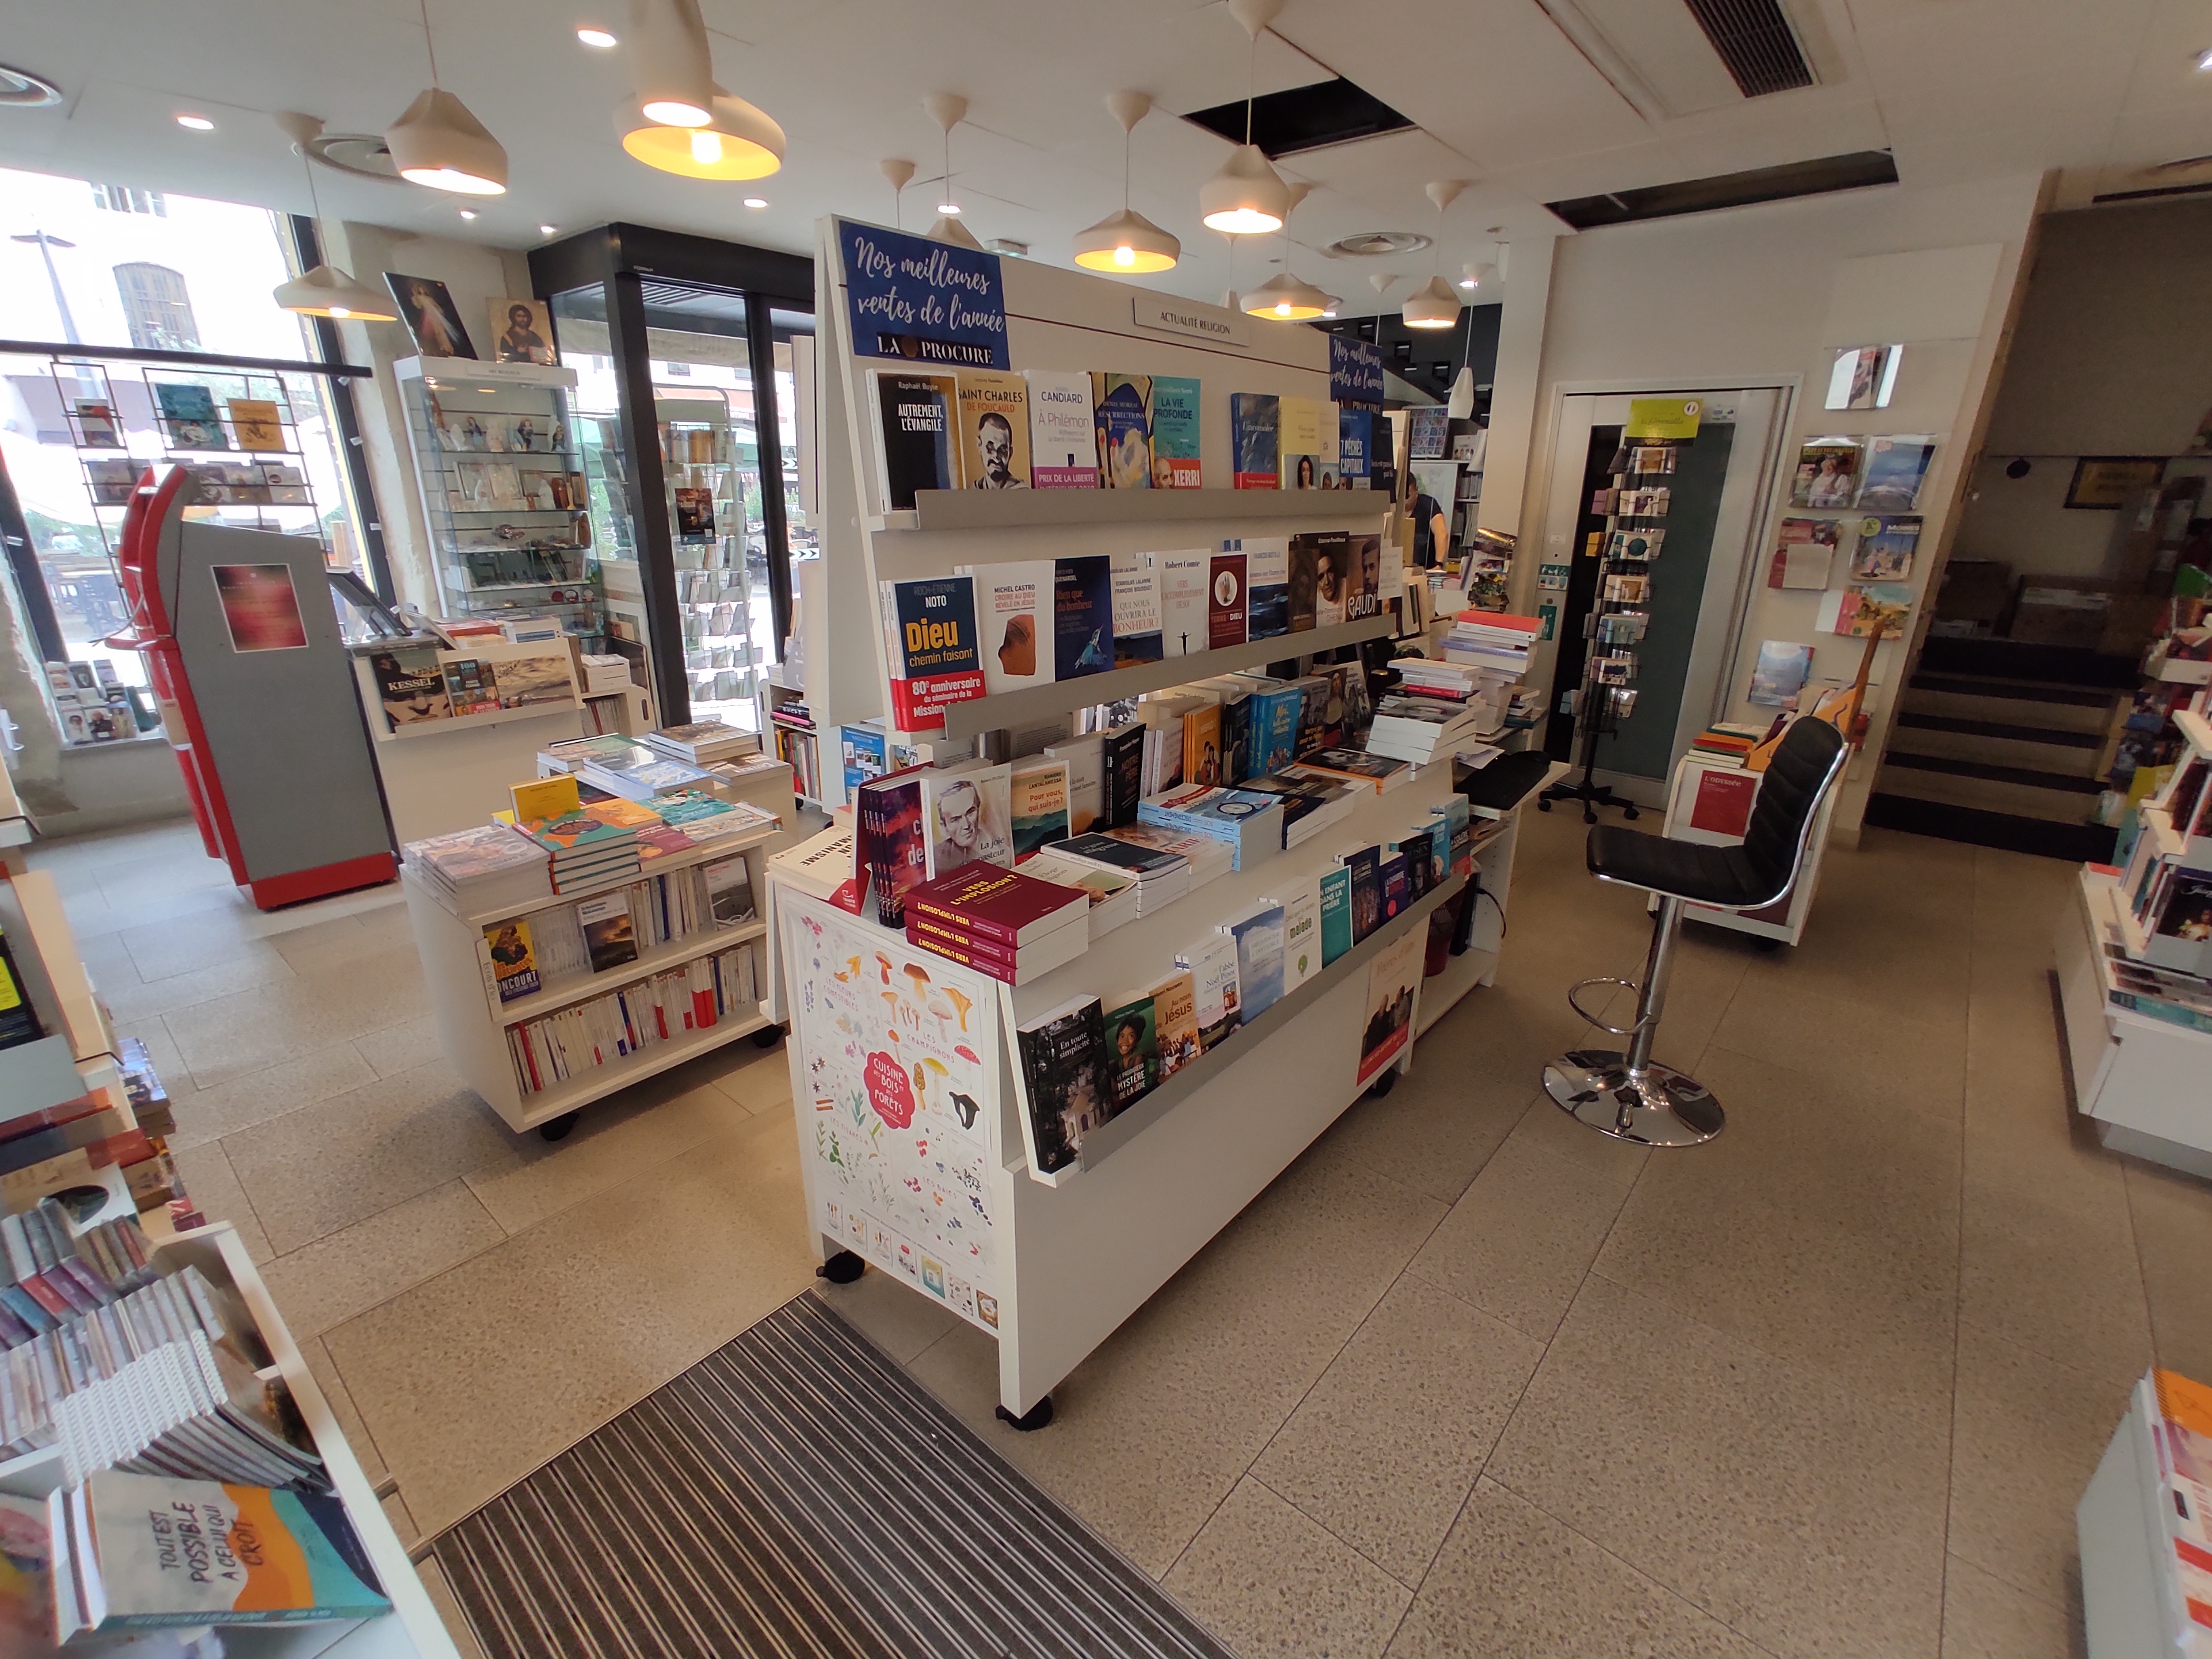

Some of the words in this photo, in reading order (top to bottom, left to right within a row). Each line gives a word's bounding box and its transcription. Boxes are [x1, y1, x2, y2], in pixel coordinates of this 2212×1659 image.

[855, 237, 895, 278] Nos
[901, 249, 990, 295] meilleures
[858, 286, 916, 324] ventes
[920, 295, 945, 325] de
[949, 293, 1004, 333] l'année
[1160, 312, 1197, 329] ACTUALITÉ
[1200, 319, 1231, 335] RELIGION
[877, 336, 900, 354] LA
[922, 341, 993, 365] PROCURE
[1334, 339, 1349, 361] Nos
[898, 382, 921, 391] Raphaël
[958, 388, 982, 401] SAINT
[985, 390, 1023, 403] CHARLES
[1041, 391, 1083, 404] CANDIARD
[1161, 397, 1171, 407] LA
[1172, 398, 1184, 408] VIE
[898, 403, 943, 419] AUTREMENT,
[967, 402, 977, 411] DE
[978, 403, 1015, 413] FOUCAULD
[1098, 411, 1145, 419] RÉSURRECTIONS
[1153, 408, 1193, 419] PROFONDE
[901, 416, 943, 432] L'ÉVANGILE
[1048, 412, 1089, 428] Philémon
[1039, 474, 1052, 482] PRIX
[1054, 474, 1063, 483] DE
[1063, 474, 1072, 483] LA
[1074, 473, 1094, 482] LIBERTÉ
[1173, 469, 1200, 487] XERRI
[1165, 560, 1183, 569] Robert
[994, 586, 1013, 594] MICHEL
[1015, 584, 1035, 592] CASTRO
[994, 593, 1012, 602] CROIRE
[1023, 591, 1035, 599] DIEU
[1056, 590, 1071, 600] Rien
[1071, 591, 1084, 601] que
[925, 595, 947, 609] NOTO
[1120, 601, 1131, 611] QUI
[1132, 599, 1150, 609] NOUS
[1114, 610, 1147, 621] OUVRIRA
[1148, 608, 1155, 617] LE
[1230, 611, 1242, 620] DIEU
[1113, 618, 1154, 634] BONHEUR
[906, 618, 959, 653] Dieu
[909, 650, 941, 668] chemin
[943, 648, 973, 662] faisant
[388, 678, 436, 691] KESSEL
[930, 677, 981, 693] anniversaire
[914, 703, 945, 718] Mission
[1029, 778, 1062, 789] CANTALAMESSA
[1030, 794, 1045, 802] Pour
[1046, 790, 1063, 798] vous,
[1028, 803, 1038, 813] qui
[1204, 819, 1214, 827] SOS
[800, 834, 852, 867] MANISME
[980, 840, 989, 851] La
[991, 836, 1005, 848] joie
[962, 880, 989, 893] VERS
[1324, 879, 1346, 895] ENFANT
[1335, 890, 1343, 899] LA
[955, 915, 970, 926] VERS
[1290, 916, 1312, 939] malade
[955, 935, 969, 945] VERS
[955, 952, 970, 964] VERS
[497, 969, 537, 993] ONCOURT
[1206, 976, 1219, 987] Noël
[823, 985, 859, 1012] COMESTIBLES
[1179, 993, 1191, 1003] nom
[1164, 1001, 1193, 1025] Jésus
[923, 1031, 936, 1044] LES
[1060, 1040, 1070, 1050] En
[1071, 1031, 1088, 1045] toute
[907, 1034, 955, 1064] CHAMPIGNONS
[1059, 1037, 1090, 1059] simplicité
[874, 1057, 903, 1084] CUISINE
[881, 1073, 899, 1094] BOIS
[1118, 1070, 1145, 1091] MYSTÈRE
[1119, 1091, 1126, 1100] DE
[1127, 1088, 1134, 1097] LA
[1134, 1080, 1146, 1093] JOIE
[874, 1088, 903, 1115] FORÊTS
[840, 1122, 863, 1145] TISANES
[149, 1509, 171, 1534] EST
[204, 1504, 226, 1527] QUI
[172, 1502, 213, 1583] POSSIBLE
[155, 1536, 181, 1572] TOUT
